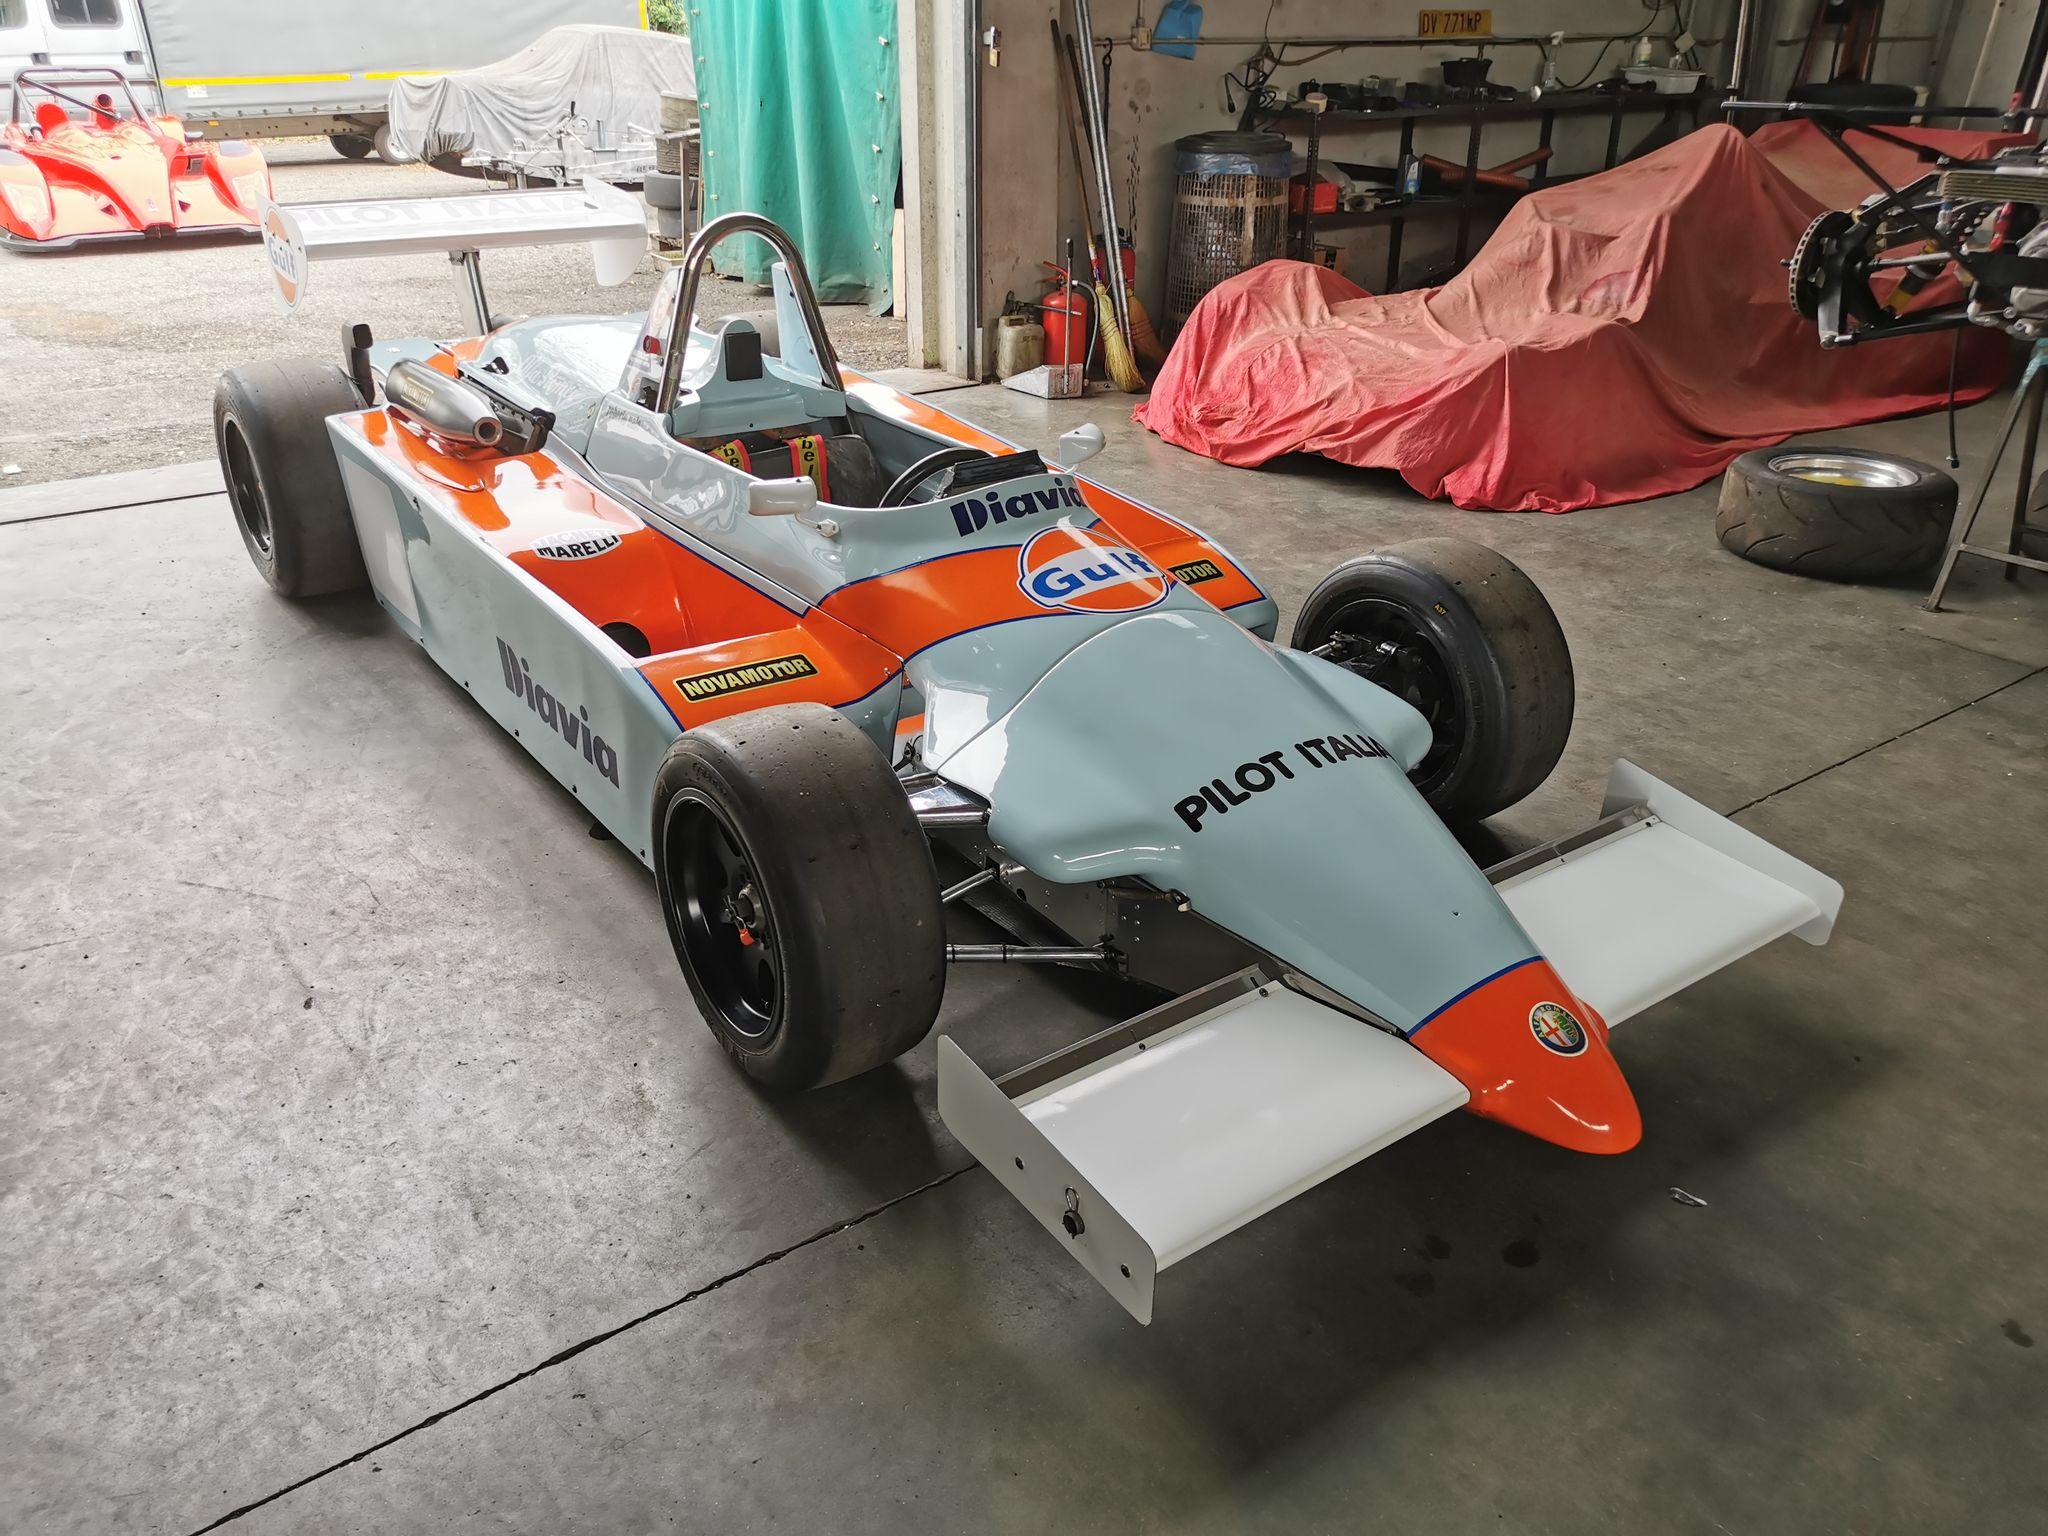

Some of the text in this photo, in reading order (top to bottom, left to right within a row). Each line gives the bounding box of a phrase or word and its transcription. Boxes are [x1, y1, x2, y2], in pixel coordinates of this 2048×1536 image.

[1422, 12, 1437, 34] DV
[268, 236, 296, 279] Gulf
[950, 477, 1088, 537] Diavia
[536, 535, 620, 558] MARELLI
[1032, 549, 1154, 599] Gulf
[682, 658, 812, 698] NOVAMOTOR
[496, 636, 620, 789] Diavia
[1173, 734, 1391, 833] PILOT ITALIA
